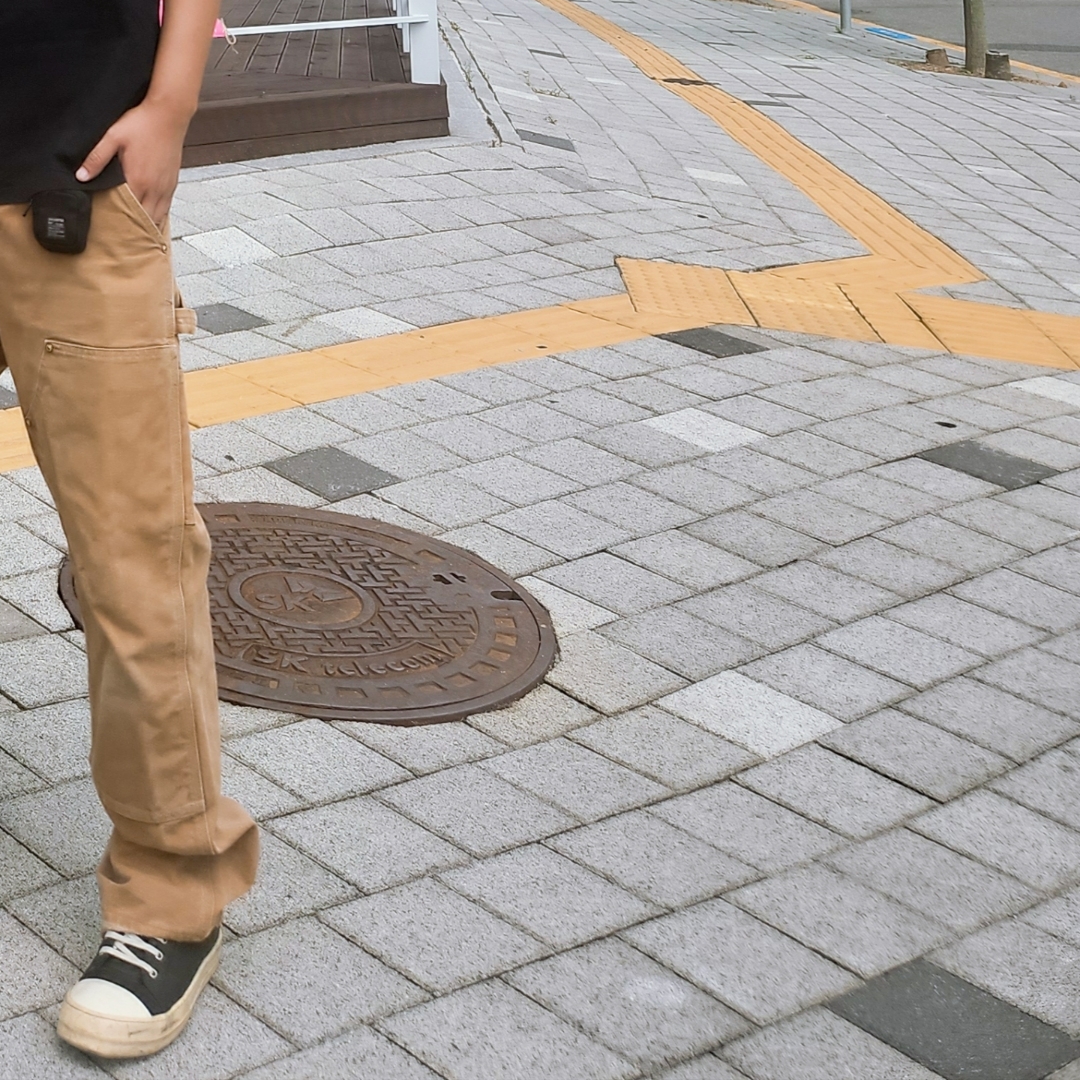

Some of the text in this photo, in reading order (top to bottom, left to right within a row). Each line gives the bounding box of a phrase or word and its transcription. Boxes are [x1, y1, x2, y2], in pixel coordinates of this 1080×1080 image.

[255, 592, 316, 613] SK
[252, 646, 445, 677] SK telecom
